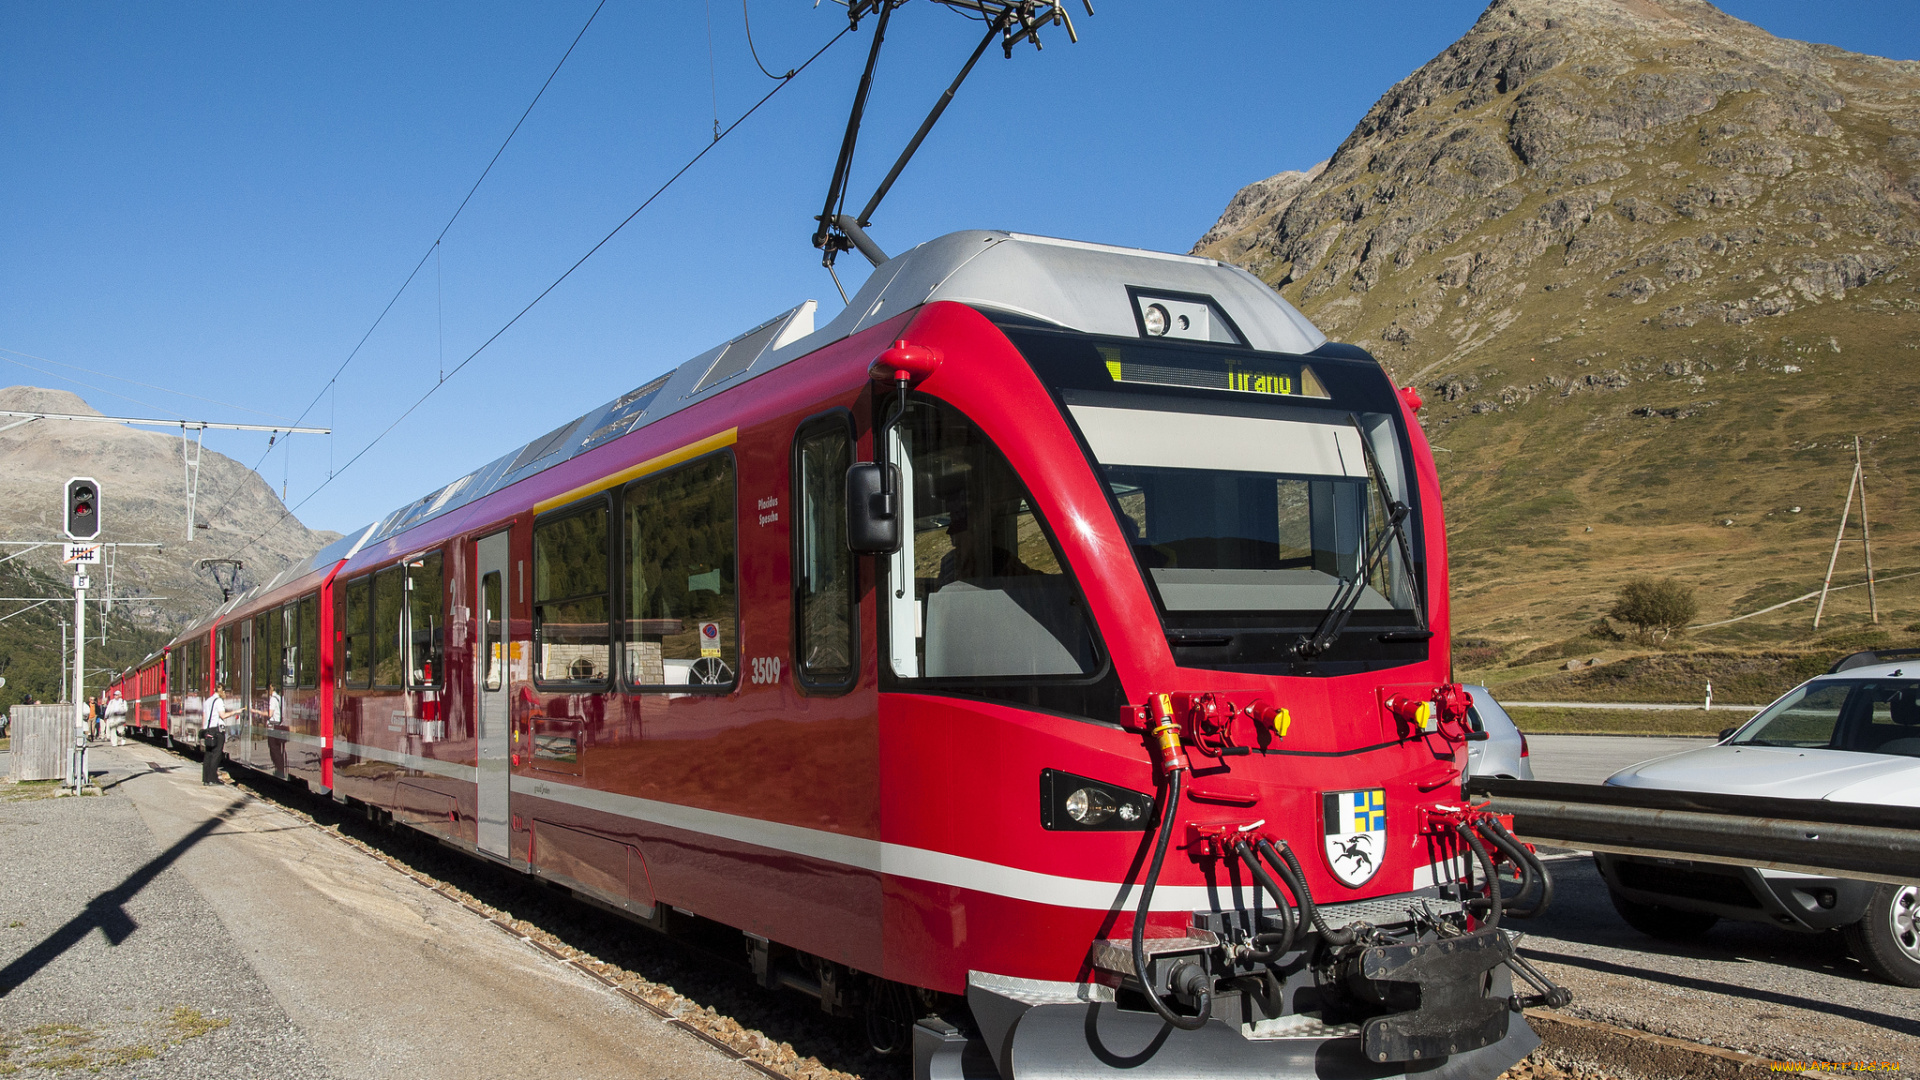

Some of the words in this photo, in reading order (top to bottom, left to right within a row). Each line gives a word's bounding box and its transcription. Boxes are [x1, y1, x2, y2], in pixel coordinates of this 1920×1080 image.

[1225, 359, 1291, 395] Tirano
[758, 495, 778, 510] Placidus
[759, 510, 778, 527] Spescha
[449, 578, 456, 615] 2
[518, 560, 524, 603] 1
[751, 656, 780, 684] 3509
